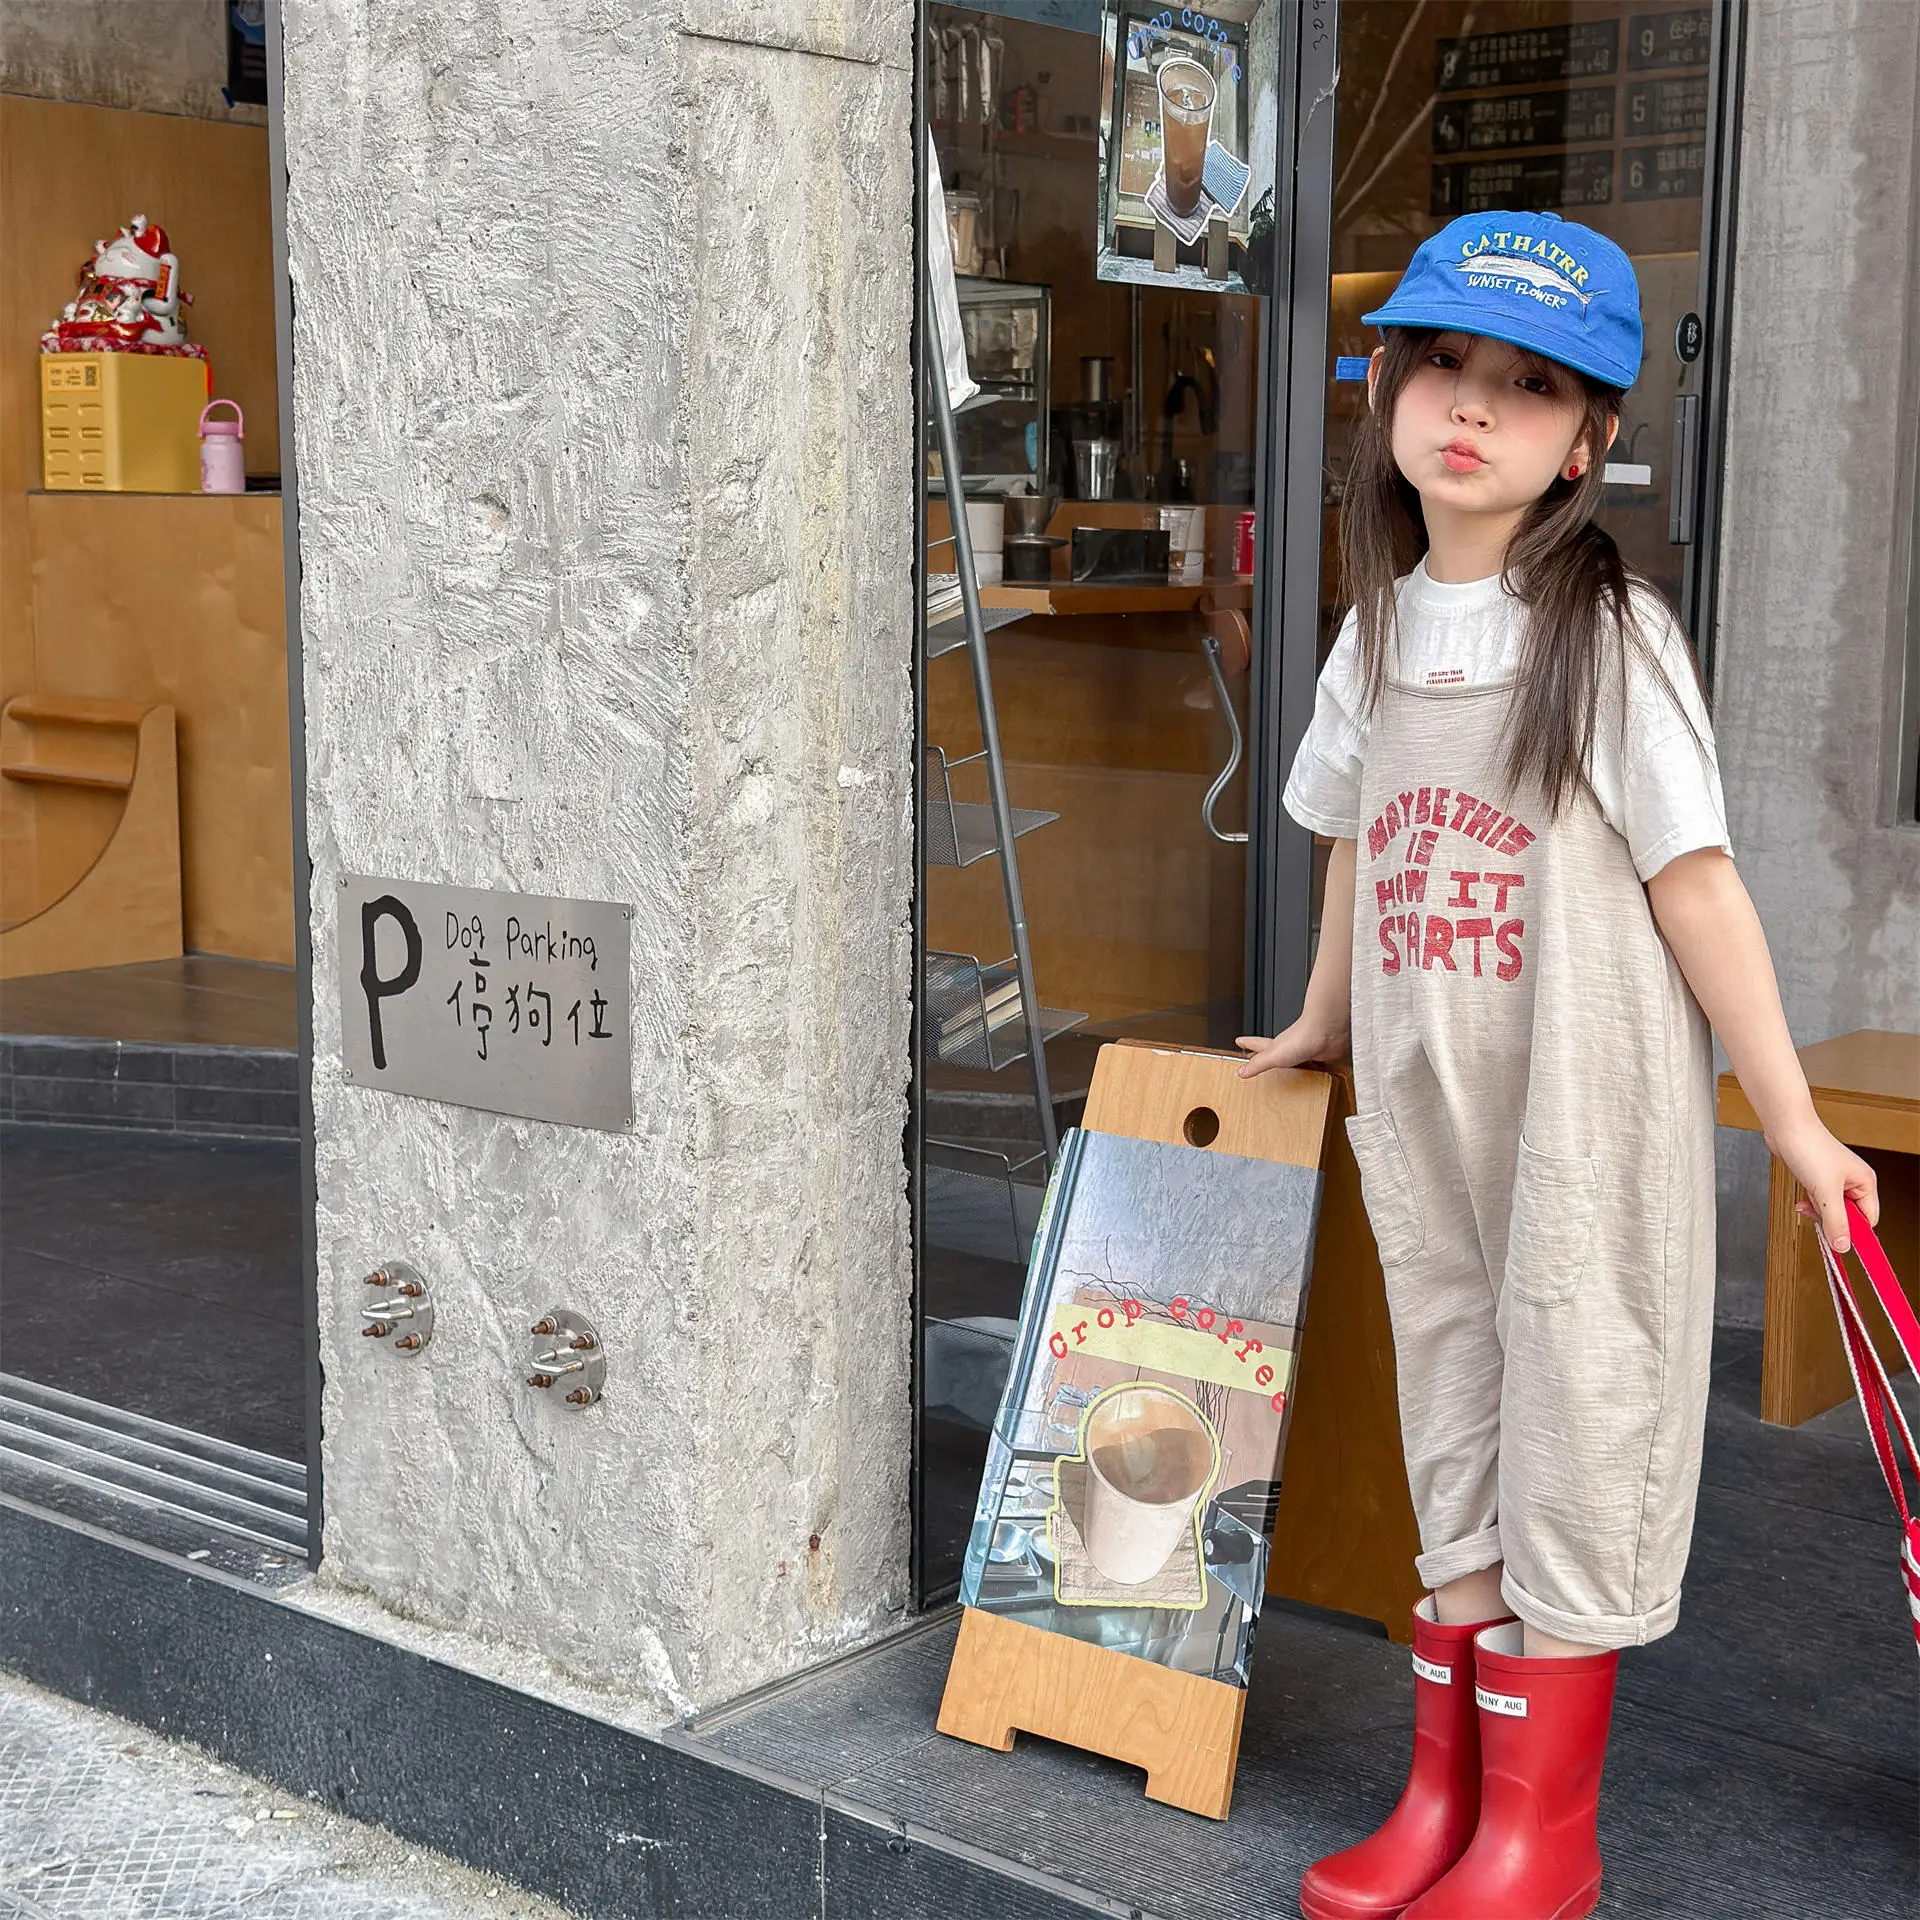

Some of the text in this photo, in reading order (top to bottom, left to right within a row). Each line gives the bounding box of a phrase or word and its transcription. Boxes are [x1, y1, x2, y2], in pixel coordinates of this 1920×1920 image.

[1632, 94, 1646, 122] 5
[1630, 161, 1645, 188] 6
[1462, 231, 1589, 287] CATHATRR
[1467, 274, 1515, 290] SUNSET
[1366, 787, 1537, 863] MAYBE THIS
[1405, 830, 1440, 867] IS
[1375, 869, 1526, 916] HOW IT
[446, 911, 598, 971] Dog Parking
[360, 894, 423, 1071] P
[446, 951, 613, 1061] 停狗位
[1049, 1297, 1287, 1413] Crop coffee
[1504, 1700, 1522, 1711] AUG
